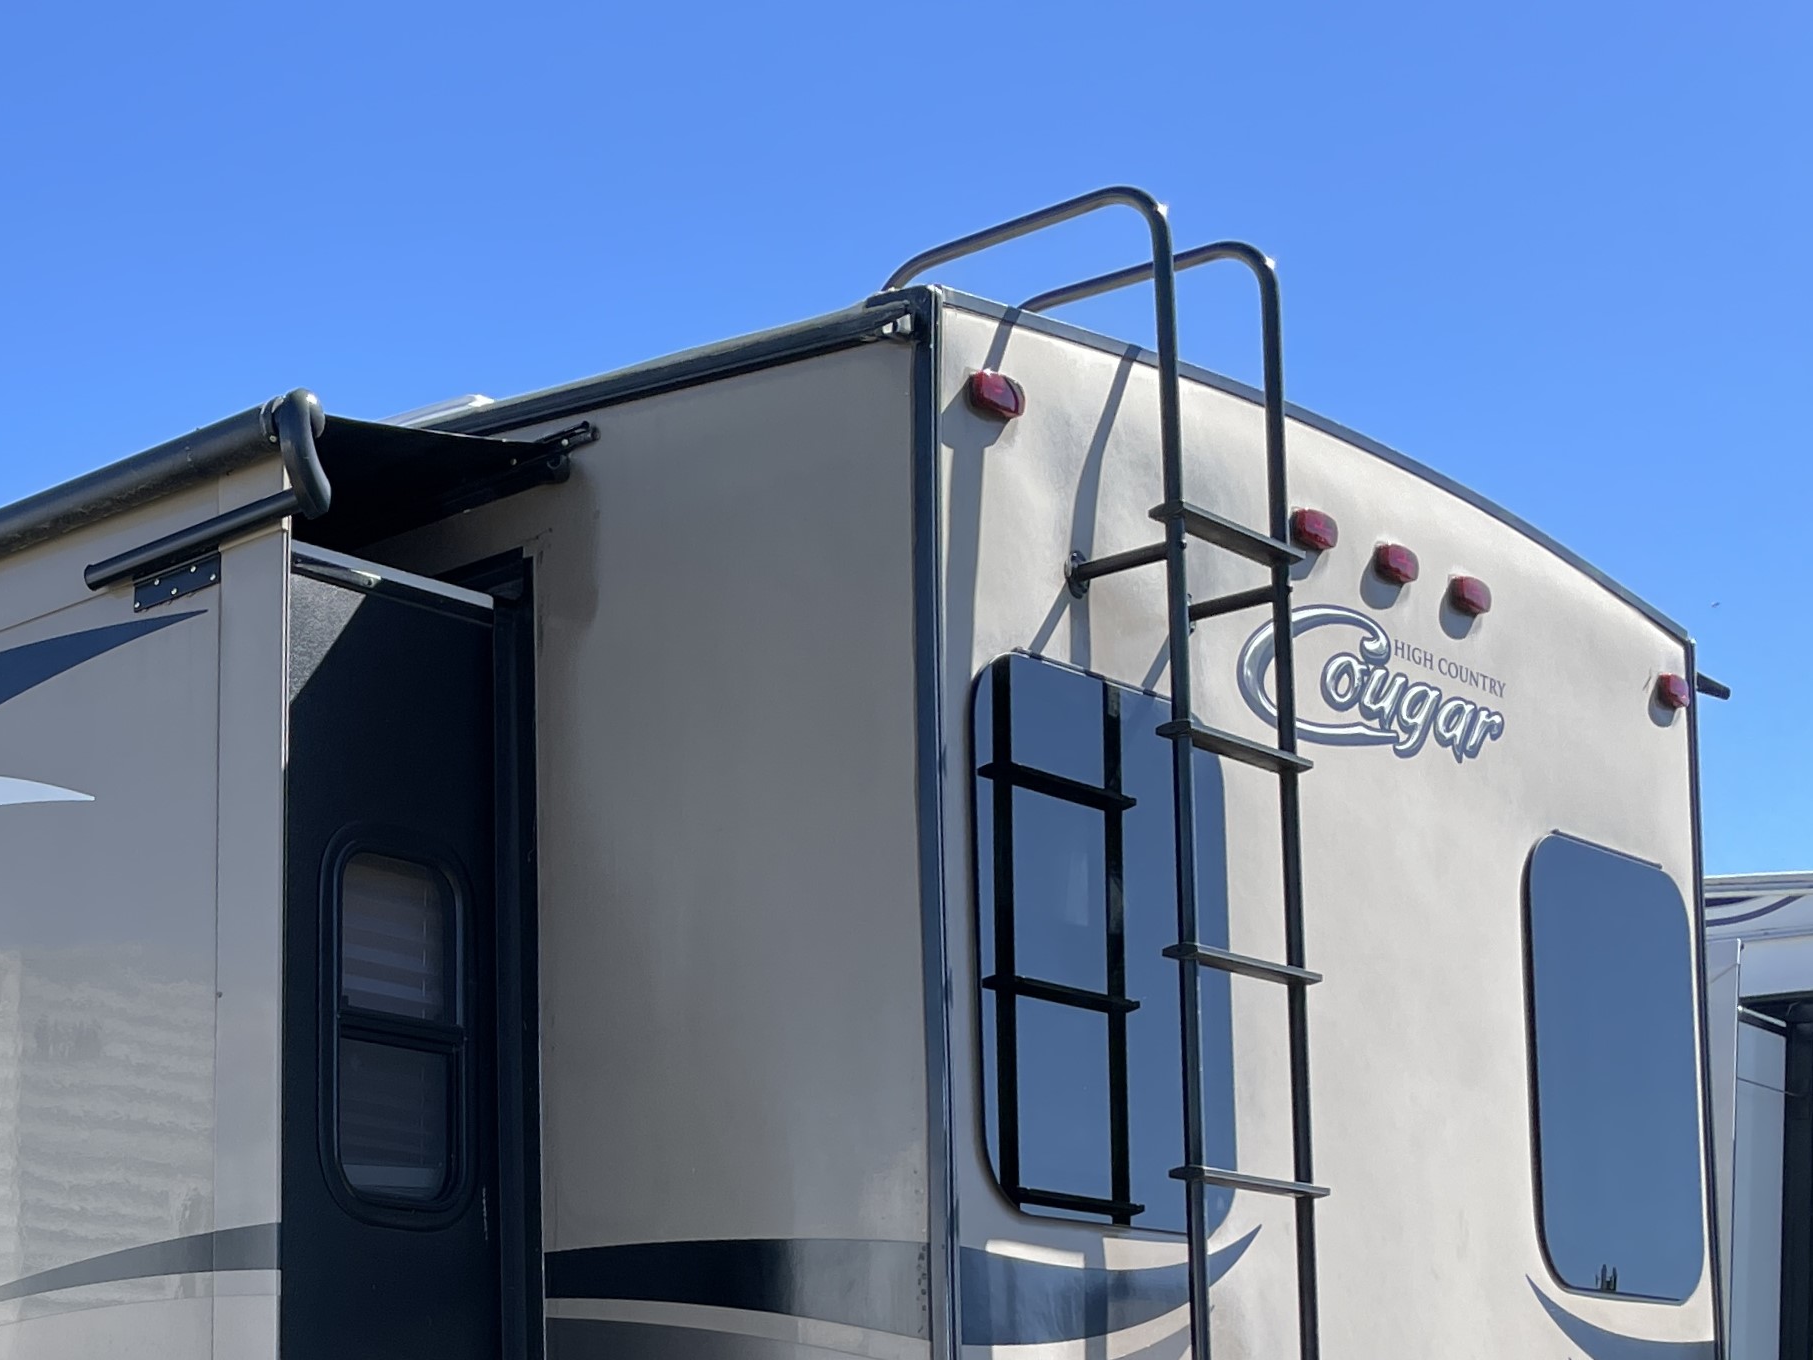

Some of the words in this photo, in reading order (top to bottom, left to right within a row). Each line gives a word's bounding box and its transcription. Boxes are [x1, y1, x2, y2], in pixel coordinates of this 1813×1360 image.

[1237, 604, 1504, 763] Cougar
[1393, 639, 1435, 671] HIGH
[1438, 658, 1507, 698] COUNTRY
